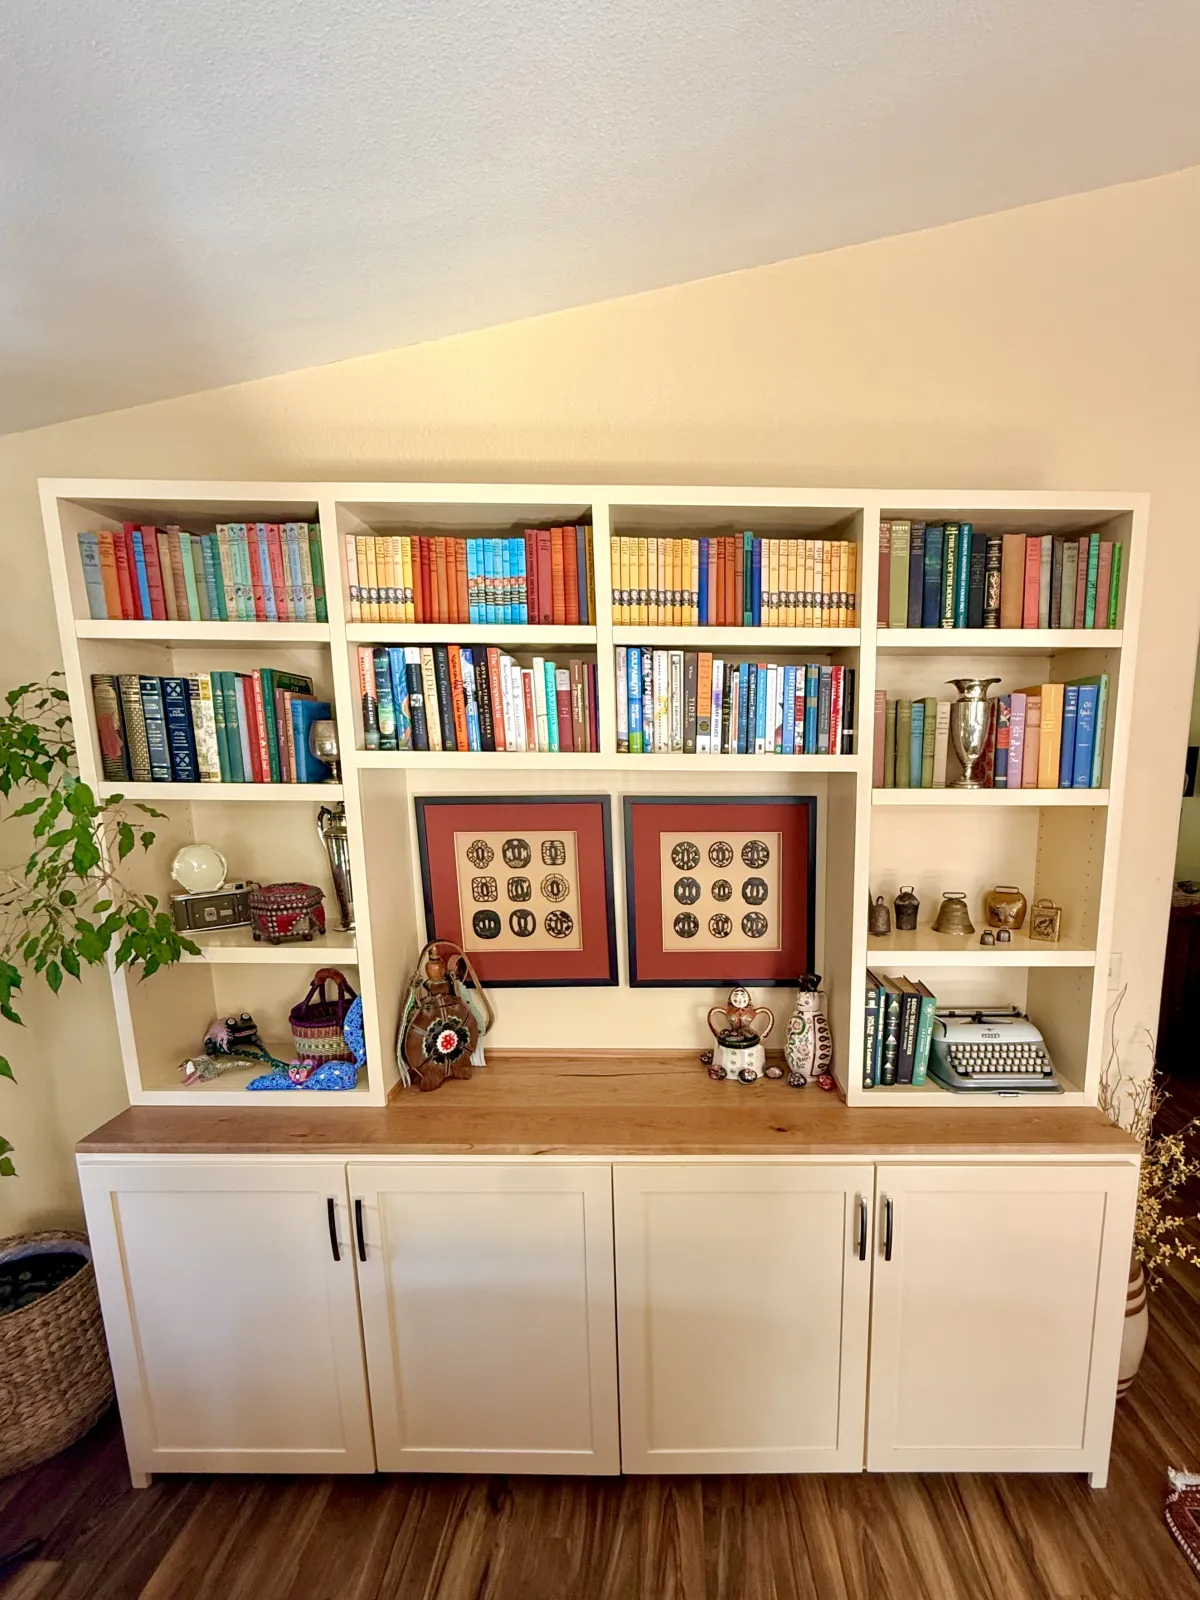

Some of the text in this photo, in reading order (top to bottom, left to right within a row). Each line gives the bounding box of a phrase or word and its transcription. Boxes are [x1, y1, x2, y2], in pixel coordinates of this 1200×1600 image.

[948, 563, 953, 572] OF
[423, 654, 434, 700] INFIDEL
[437, 651, 445, 662] All
[631, 651, 639, 696] CULPABILITY
[464, 672, 474, 716] SNOWSTRUCK
[492, 668, 501, 718] Correspondent
[644, 676, 652, 718] DEPENDENT
